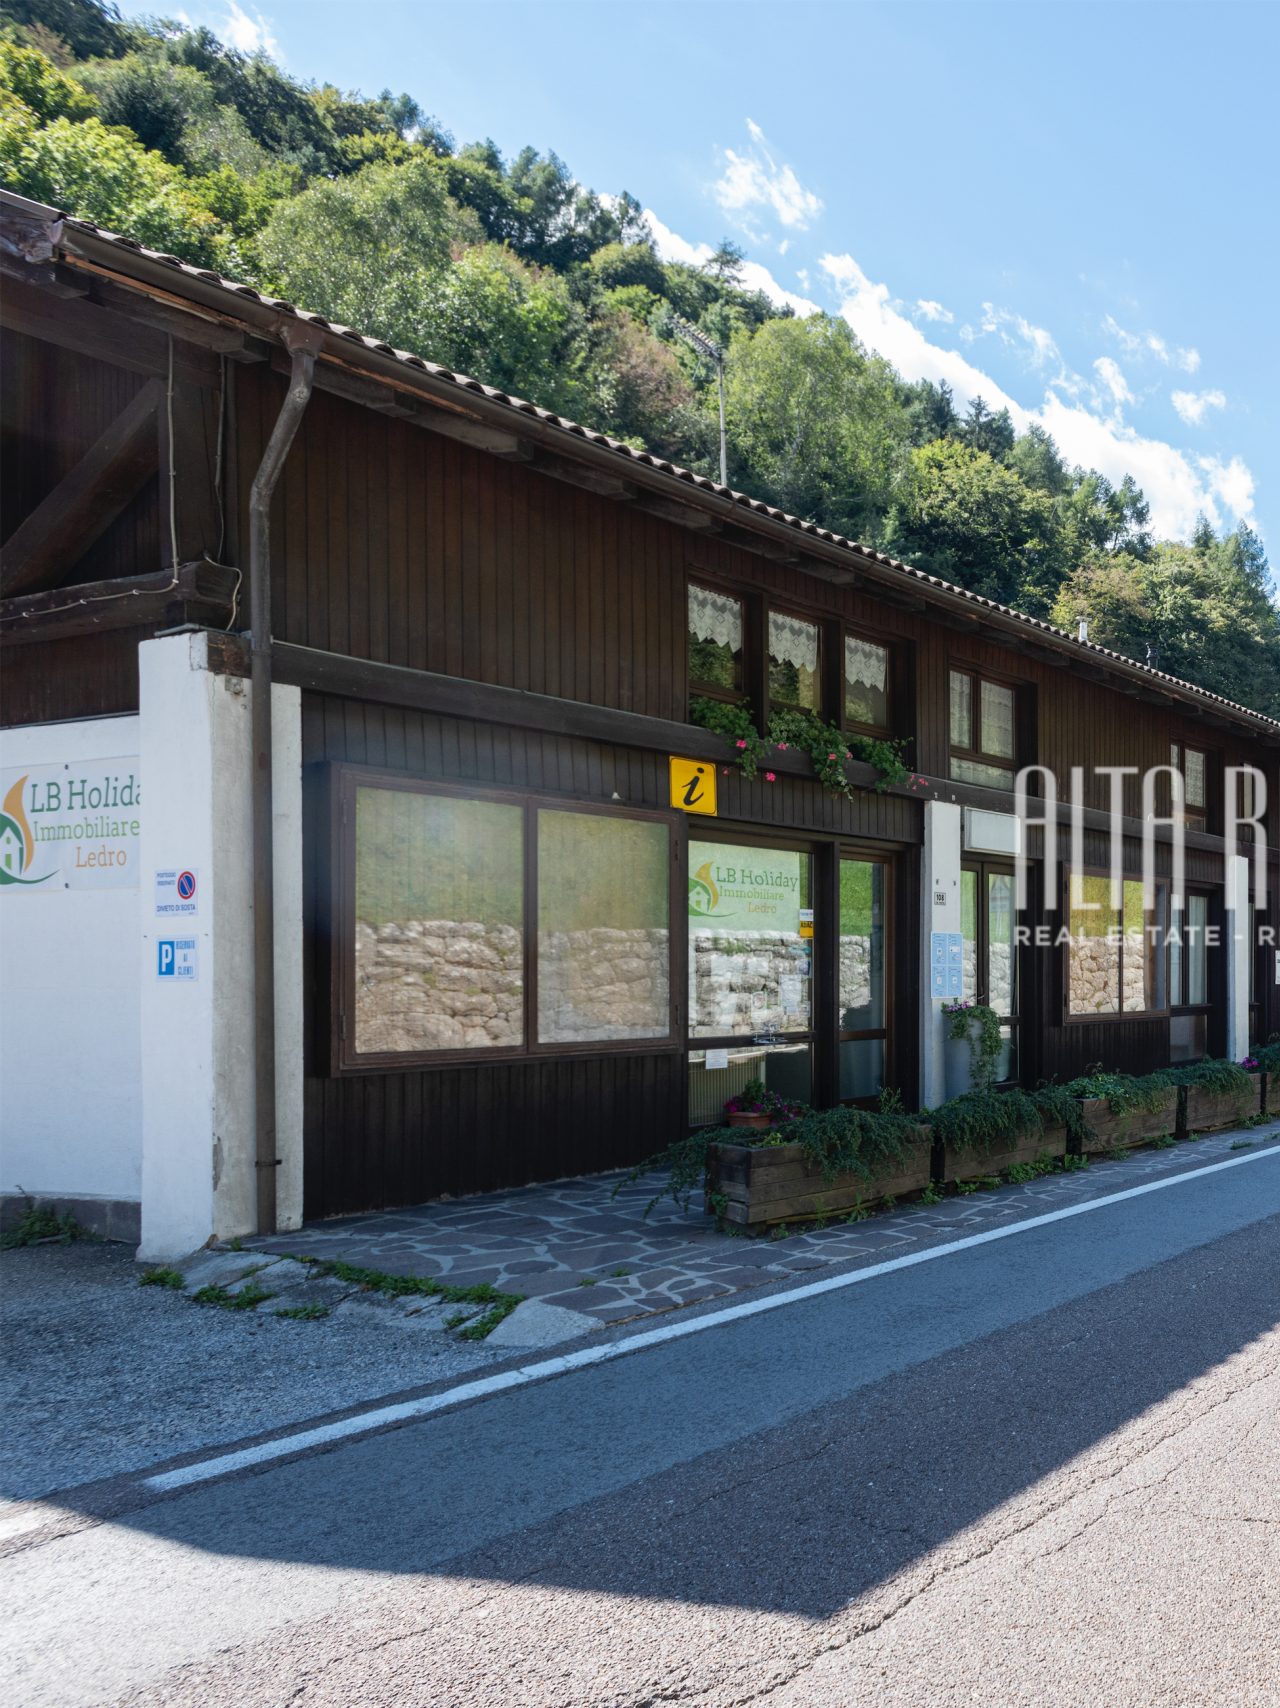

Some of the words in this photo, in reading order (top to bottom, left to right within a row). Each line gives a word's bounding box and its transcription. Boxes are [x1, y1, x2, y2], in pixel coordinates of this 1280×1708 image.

[30, 782, 61, 813] LB
[33, 816, 140, 842] Immobiliare
[75, 845, 127, 868] Ledro
[716, 867, 736, 883] LB
[740, 869, 798, 892] Holiday
[719, 886, 784, 901] Immobiliare
[748, 902, 777, 914] Ledro
[161, 944, 172, 972] P
